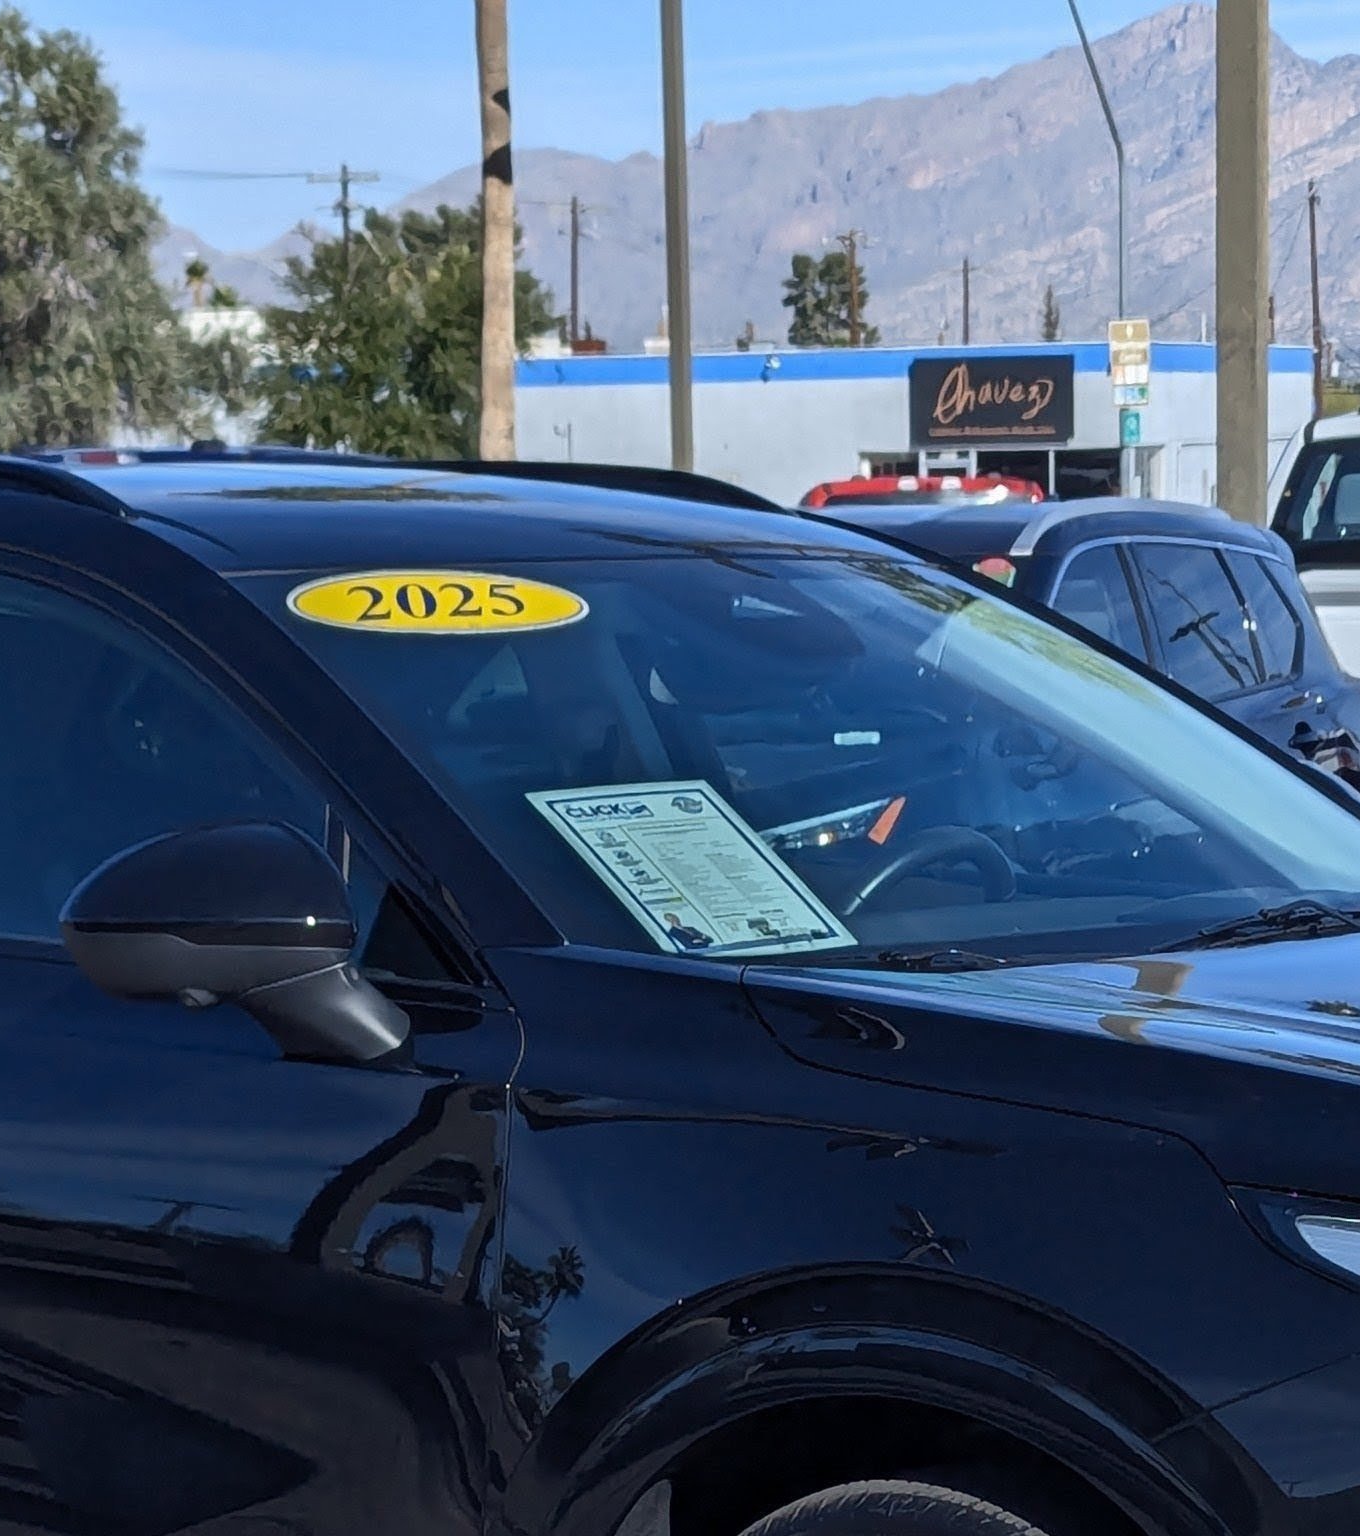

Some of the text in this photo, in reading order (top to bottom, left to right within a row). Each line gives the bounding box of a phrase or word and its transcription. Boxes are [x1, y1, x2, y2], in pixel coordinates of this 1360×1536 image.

[933, 363, 1054, 424] Chavez
[346, 583, 524, 622] 2025
[565, 803, 627, 819] CLICK
